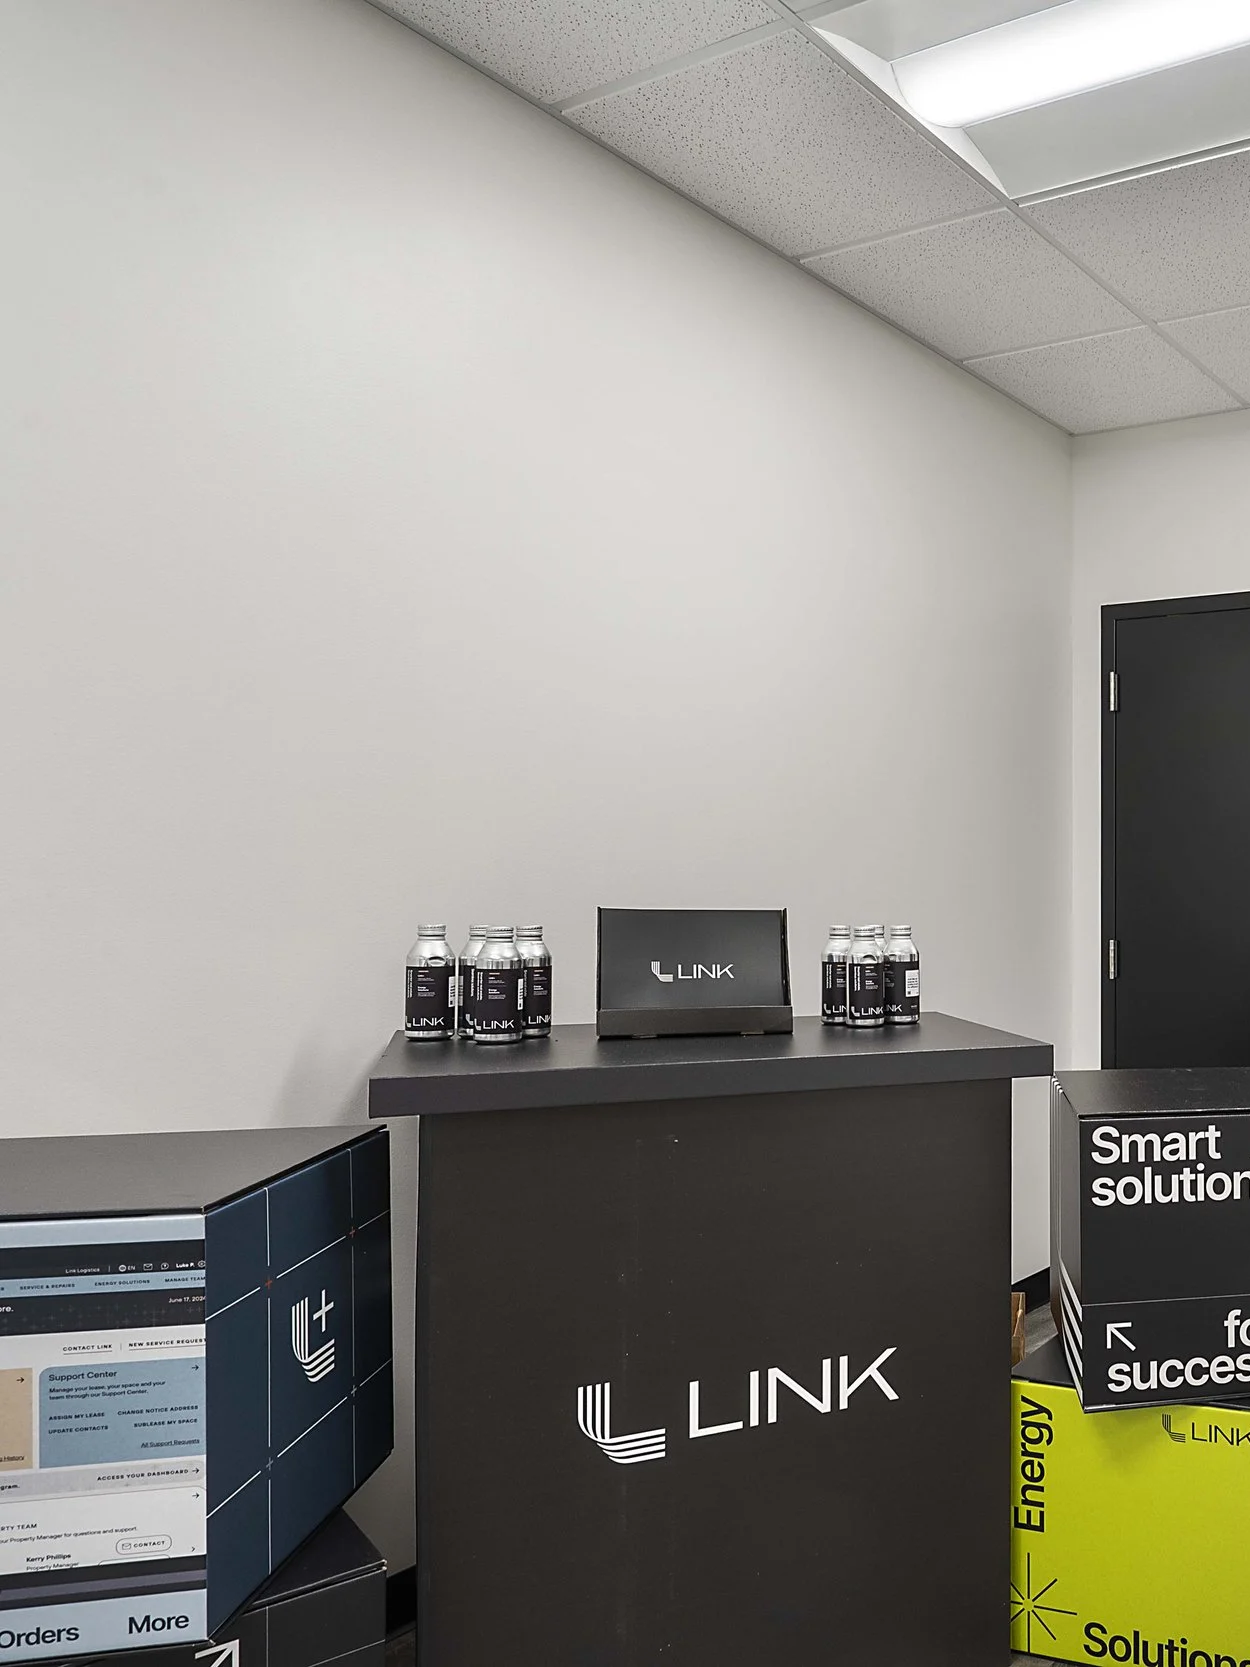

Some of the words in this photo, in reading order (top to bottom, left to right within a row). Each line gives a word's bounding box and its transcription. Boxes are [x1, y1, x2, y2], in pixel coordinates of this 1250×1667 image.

[678, 964, 735, 979] LINK
[832, 1004, 848, 1013] LIN
[861, 1005, 884, 1016] LINK
[412, 1016, 445, 1027] LINK
[482, 1019, 515, 1030] LINK
[1090, 1124, 1222, 1165] Smart
[146, 1339, 174, 1347] SERVICE
[62, 1344, 95, 1352] CONTACT
[48, 1372, 85, 1383] Support
[86, 1370, 118, 1379] Center
[688, 1346, 900, 1439] LINK
[133, 1420, 166, 1428] SUBLEASE
[74, 1425, 109, 1433] CONTACTS
[149, 1440, 173, 1448] Support
[1013, 1394, 1054, 1533] Energy
[147, 1468, 189, 1477] DASHBOARD
[72, 1530, 101, 1538] questions
[133, 1540, 165, 1548] CONTACT
[26, 1564, 52, 1572] Property
[0, 1626, 80, 1648] Orders
[128, 1614, 189, 1635] More
